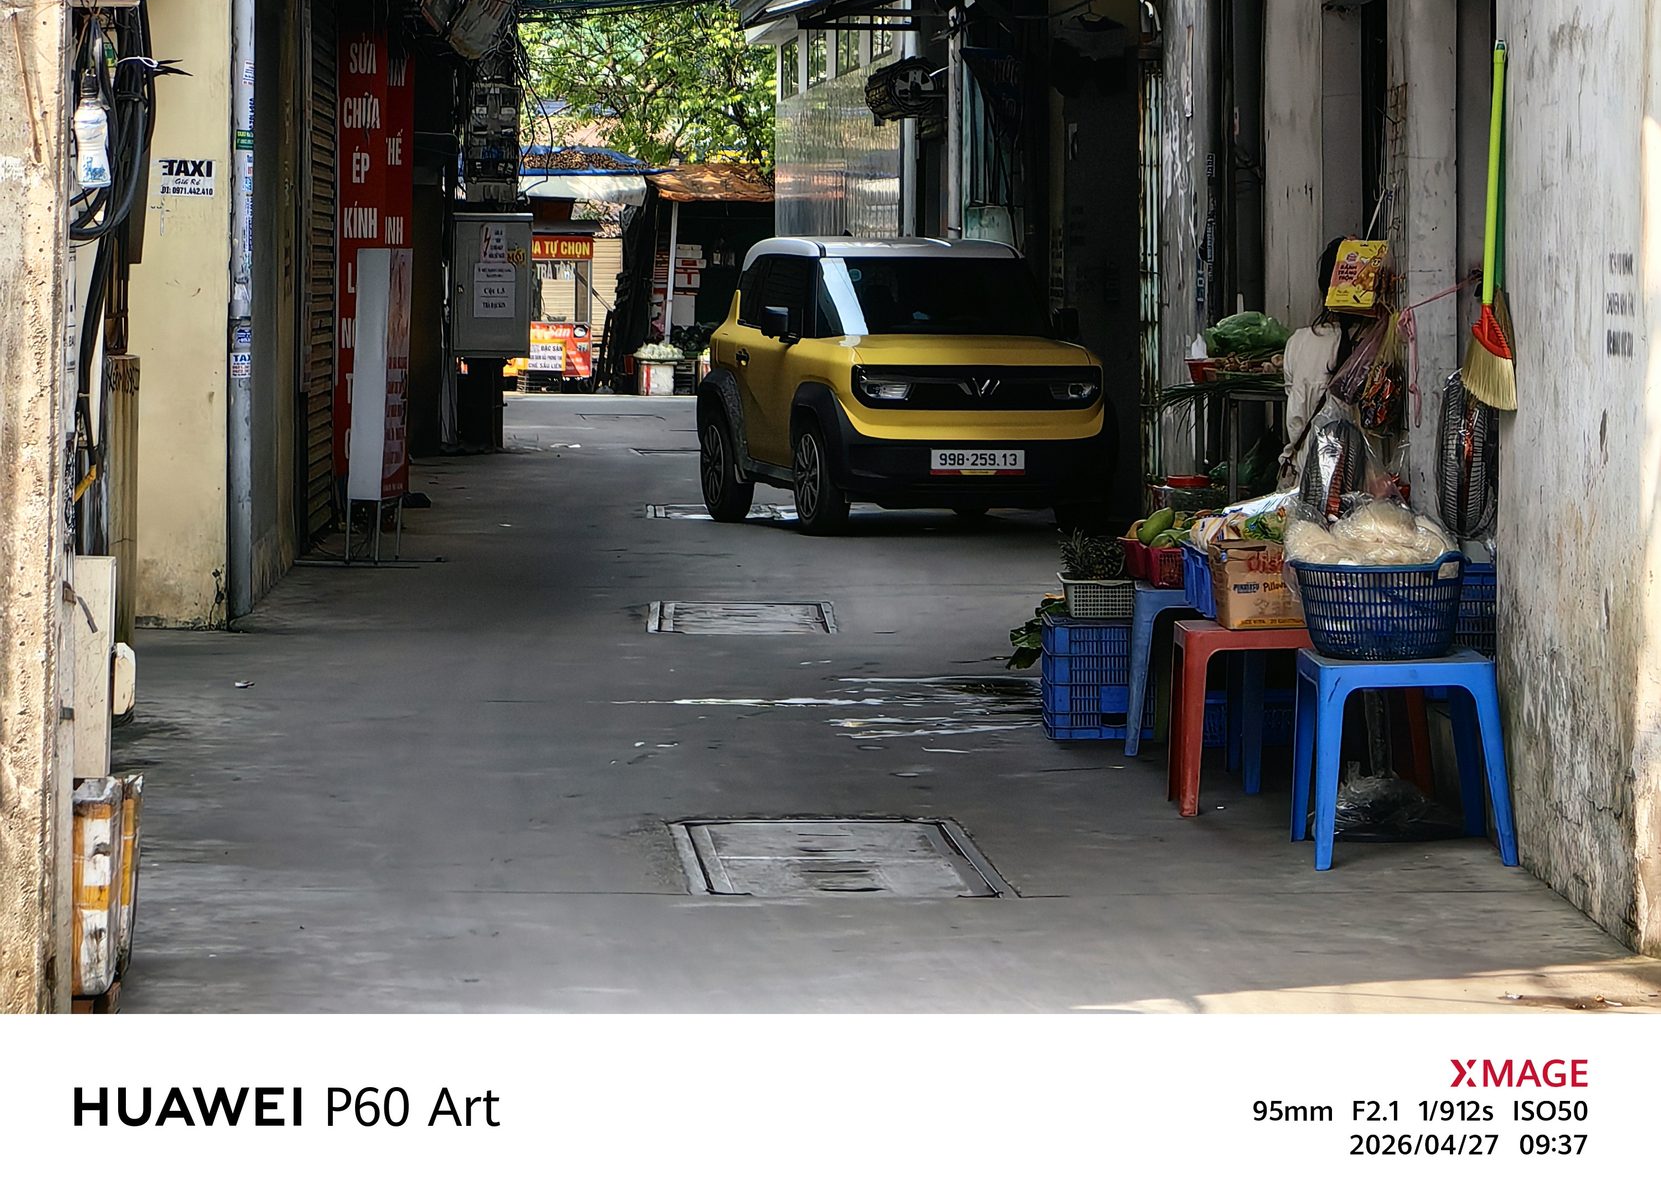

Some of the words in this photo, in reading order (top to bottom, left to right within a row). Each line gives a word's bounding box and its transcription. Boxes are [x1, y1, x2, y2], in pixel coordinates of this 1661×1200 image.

[350, 32, 377, 74] SỬA
[343, 92, 381, 129] CHỮA
[159, 160, 213, 177] TAXI
[352, 146, 370, 184] ÉP
[343, 201, 378, 239] KÍNH
[544, 240, 559, 258] TỰ
[561, 241, 590, 259] CHỌN
[939, 452, 1018, 467] 99B-259.13
